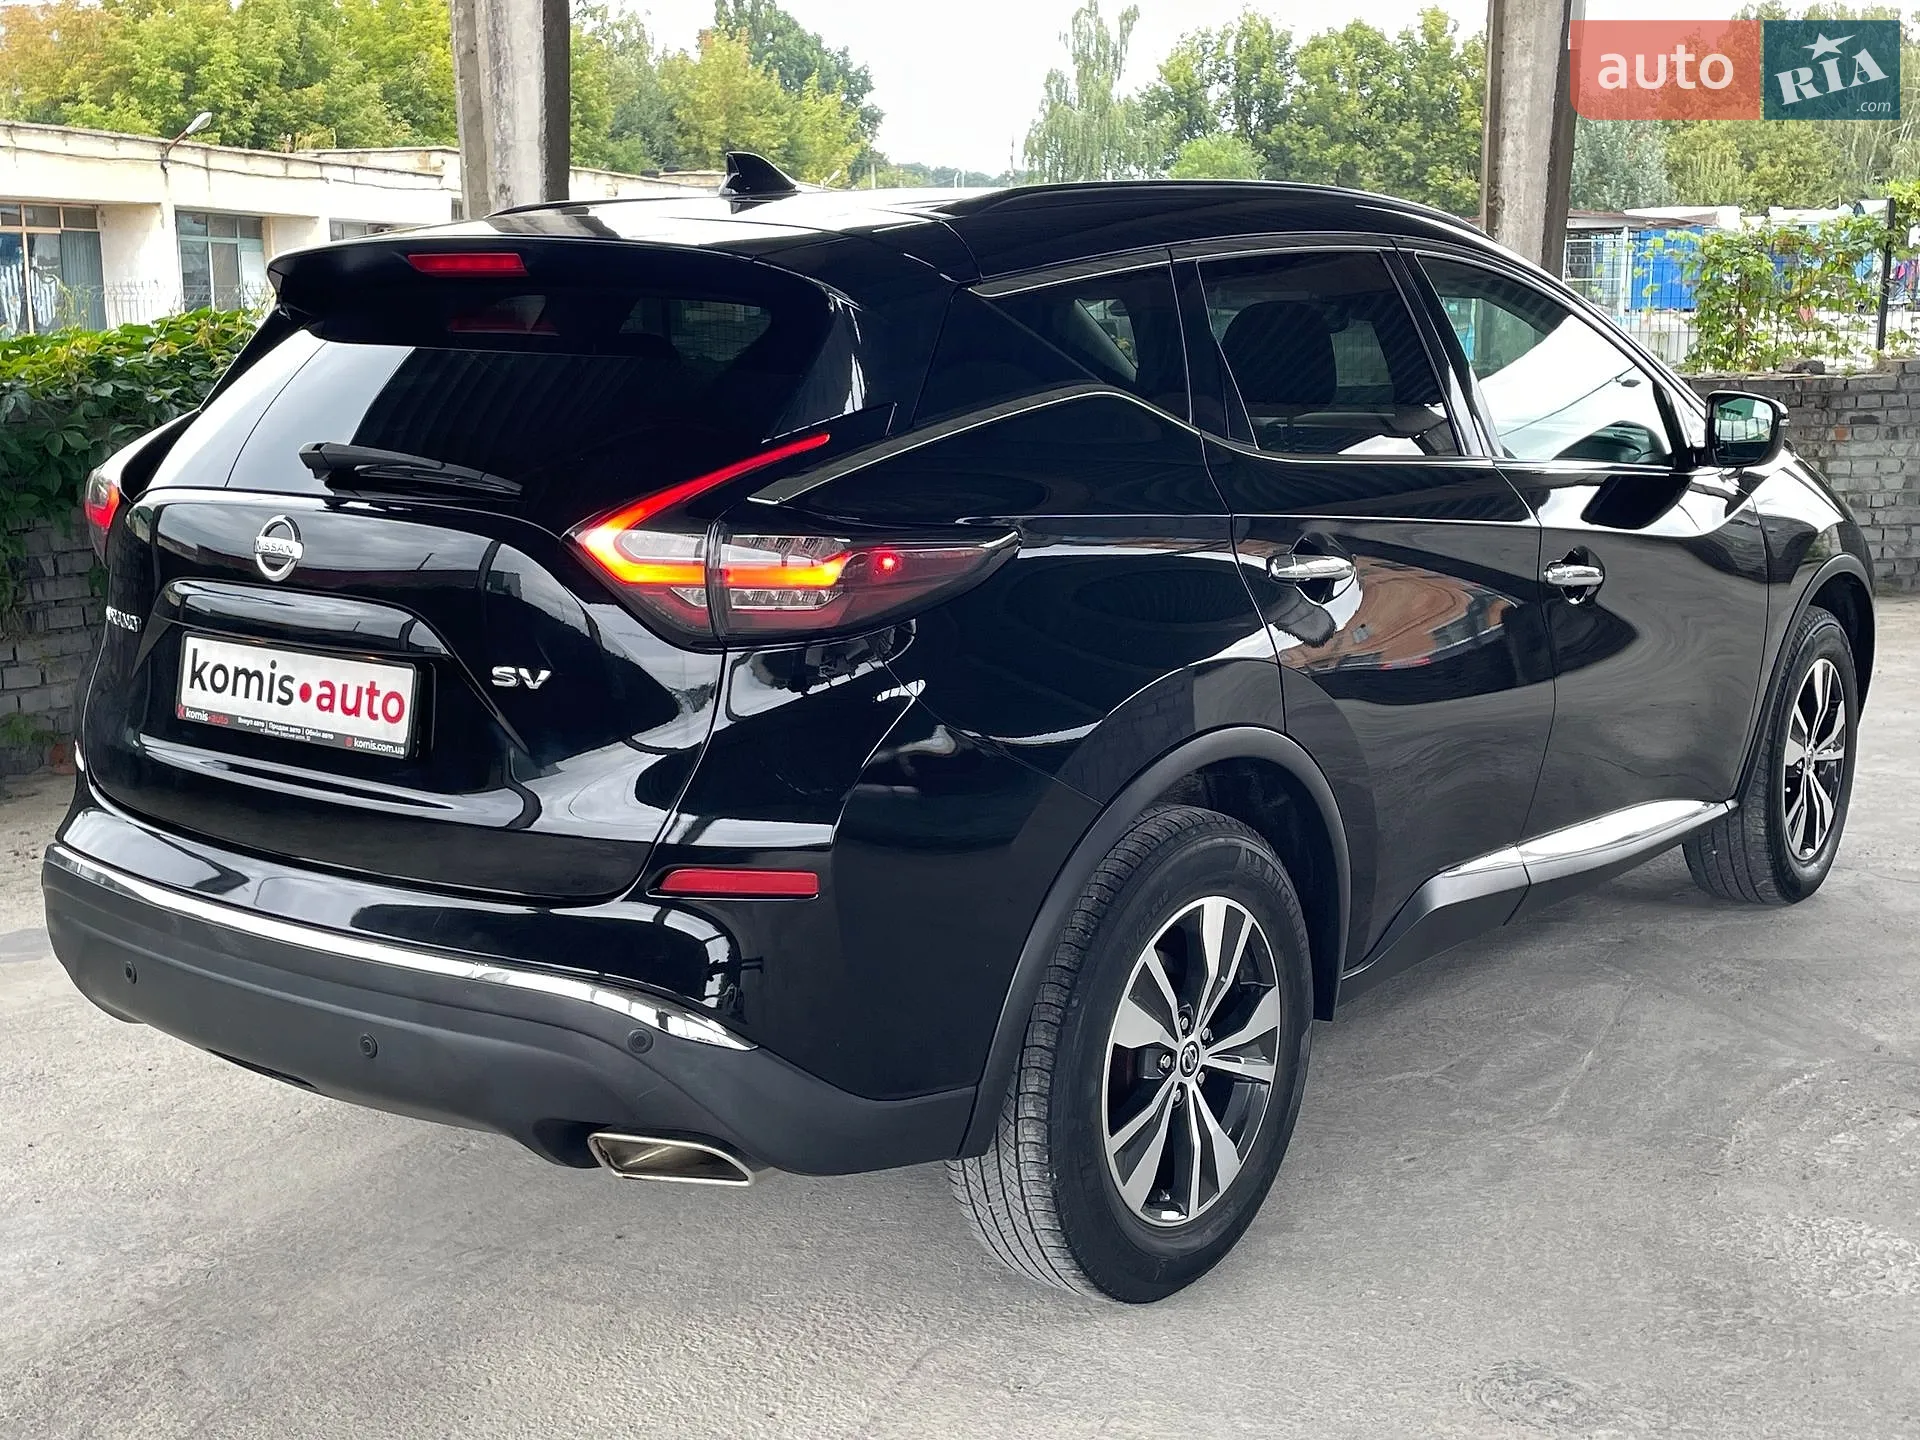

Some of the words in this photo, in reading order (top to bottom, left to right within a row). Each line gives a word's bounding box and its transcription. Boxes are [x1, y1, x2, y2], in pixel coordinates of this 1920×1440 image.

[255, 540, 294, 554] NISSAN
[491, 666, 551, 689] SV
[353, 737, 405, 755] komis.com.ua
